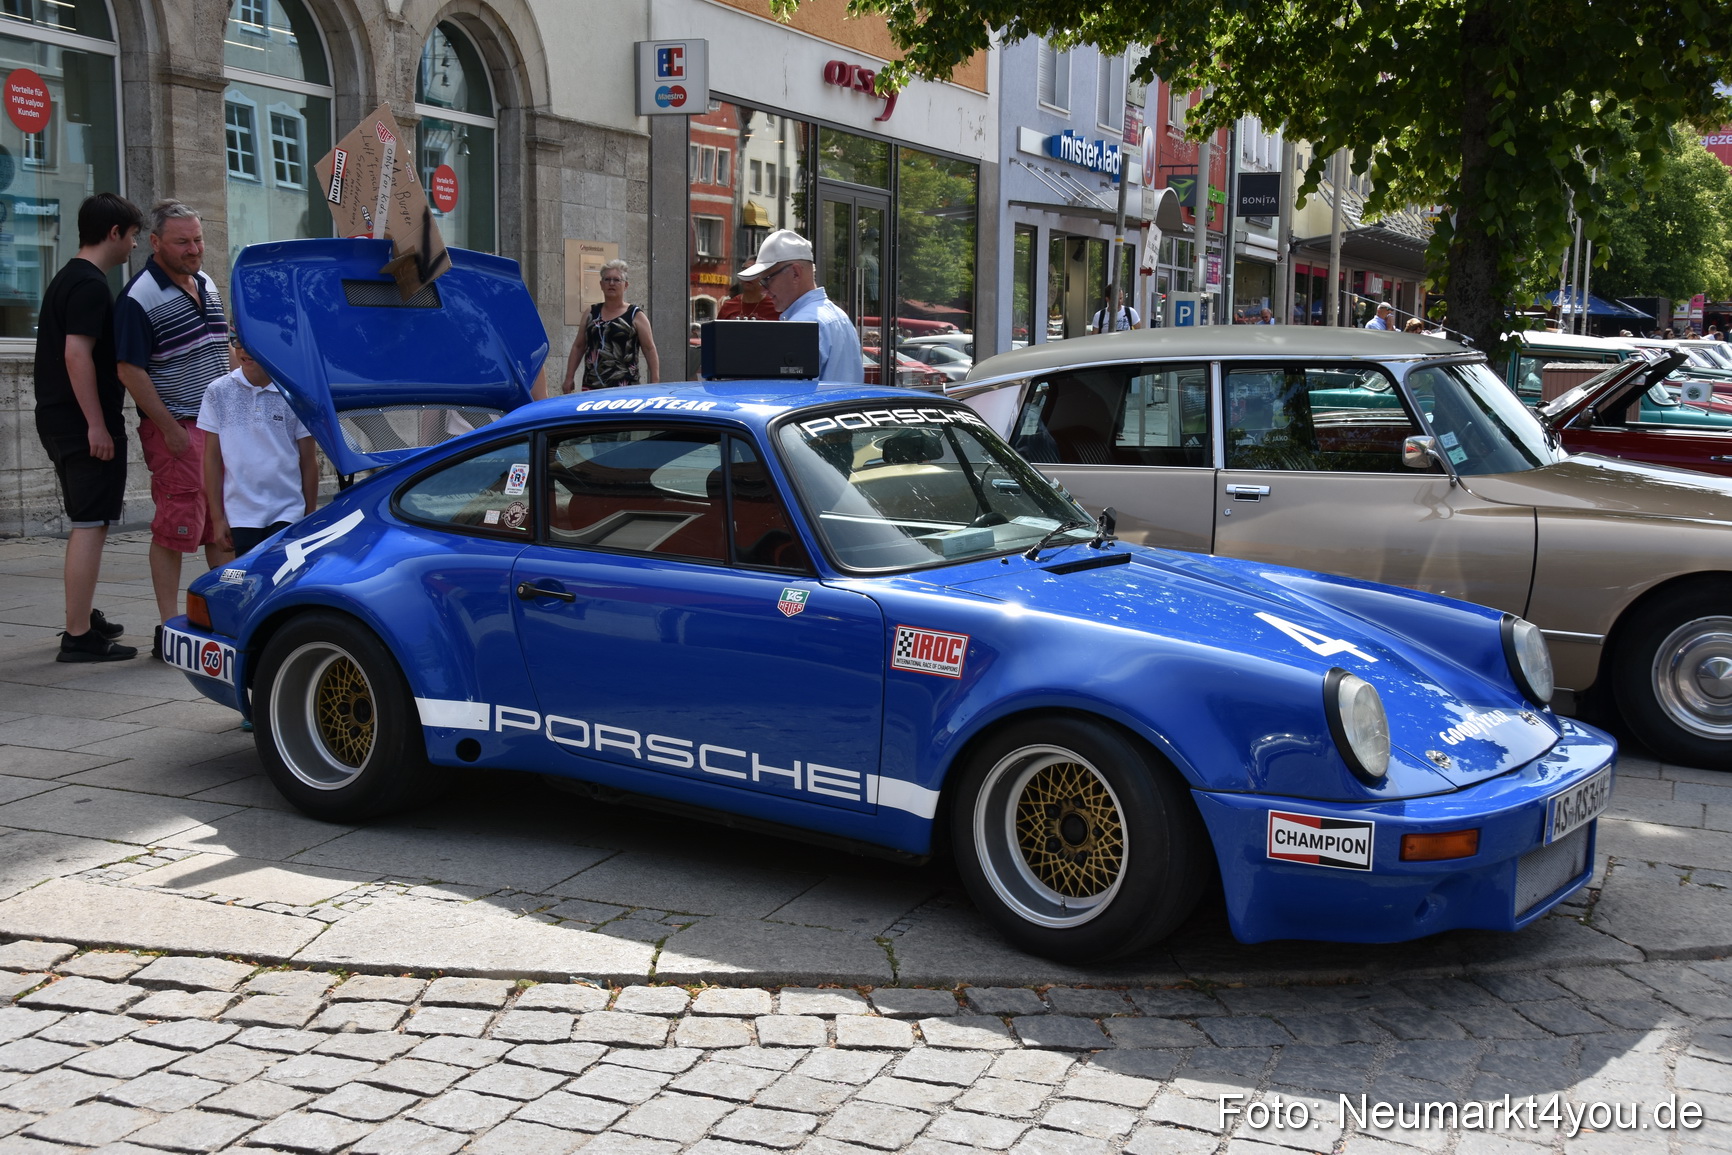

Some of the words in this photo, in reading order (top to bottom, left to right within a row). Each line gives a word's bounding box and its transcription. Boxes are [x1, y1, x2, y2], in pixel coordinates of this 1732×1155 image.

[11, 84, 34, 96] Vorteile
[34, 88, 44, 97] für
[12, 95, 25, 105] HVB
[25, 98, 44, 108] valyou
[658, 93, 684, 101] Maestro
[824, 60, 901, 121] orsy
[18, 107, 40, 118] Kunden
[1103, 140, 1122, 175] lad
[330, 151, 344, 202] CHAMPION
[383, 172, 391, 188] for
[394, 190, 412, 226] Burger
[1179, 306, 1191, 324] P
[800, 408, 989, 438] PORSCHE
[272, 508, 366, 586] 4
[786, 590, 804, 602] TAG
[778, 601, 804, 615] HEUER
[912, 632, 963, 665] IROC
[1254, 612, 1379, 663] 4
[204, 652, 220, 669] 76
[896, 658, 922, 668] INTERNATIONAL
[937, 664, 958, 673] CHAMPIONS
[495, 704, 860, 802] PORSCHE
[1275, 828, 1366, 855] CHAMPION
